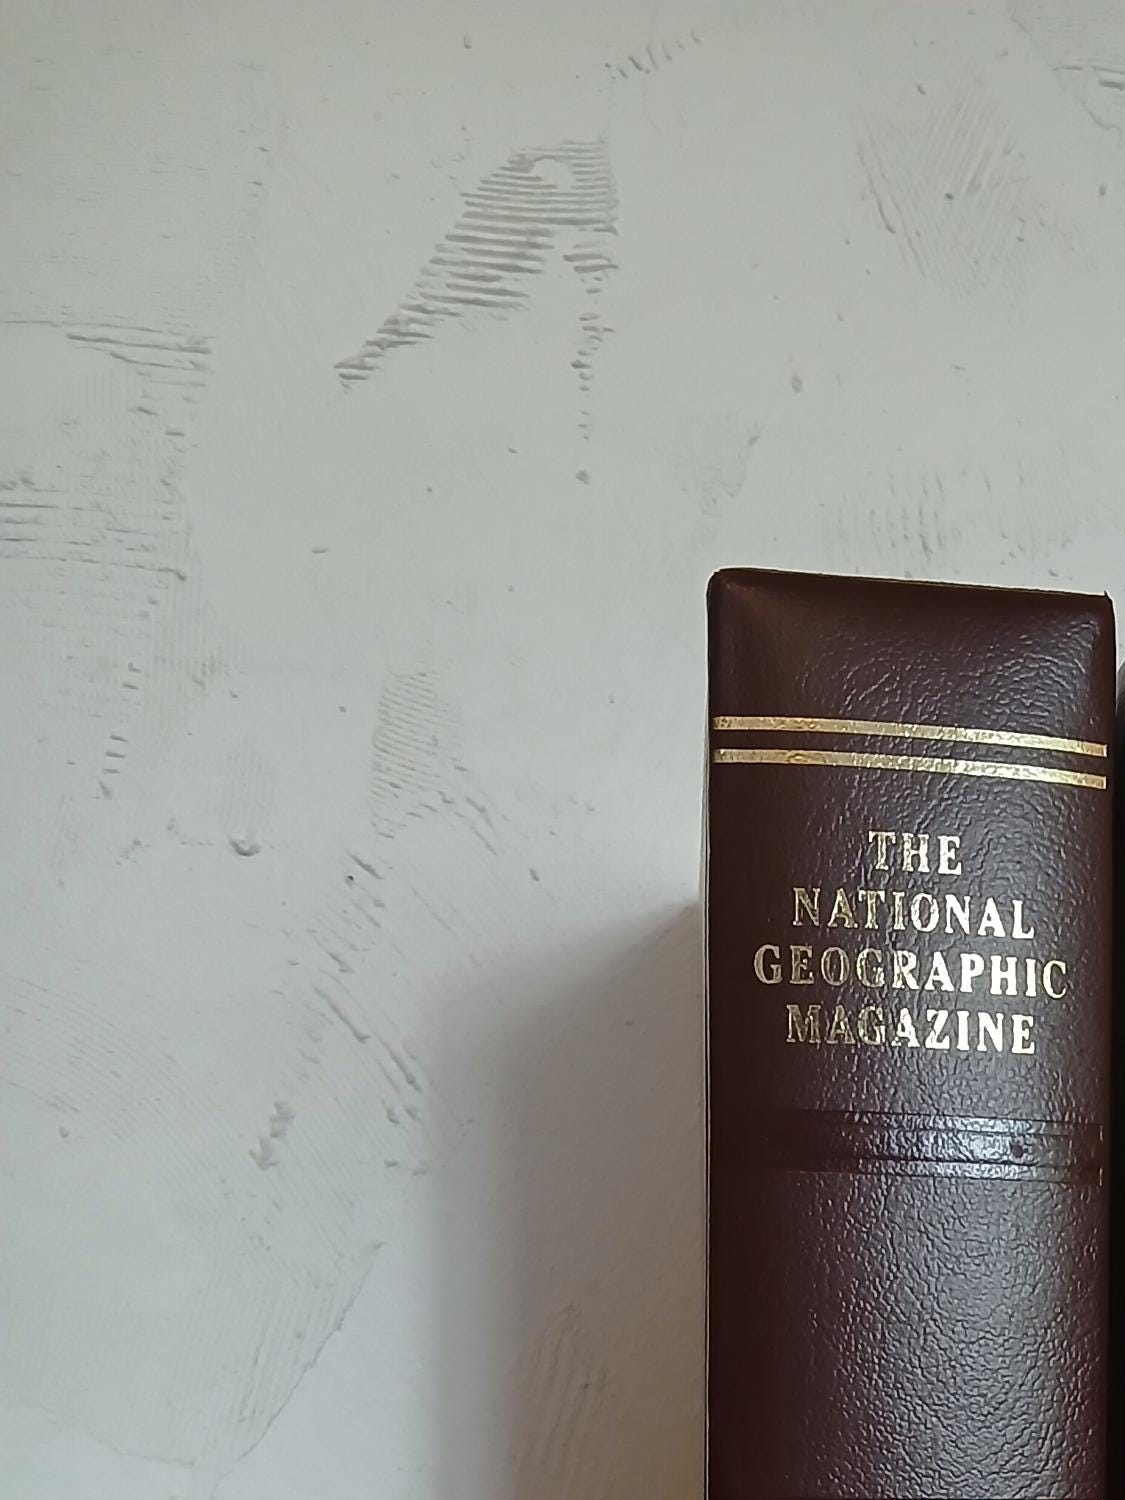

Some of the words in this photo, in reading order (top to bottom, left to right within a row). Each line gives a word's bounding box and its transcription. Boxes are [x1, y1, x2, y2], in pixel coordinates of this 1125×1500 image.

[868, 831, 962, 876] THE
[793, 887, 1035, 940] NATIONAL
[754, 944, 1068, 999] GEOGRAPHIC
[786, 1003, 1036, 1054] MAGAZINE
